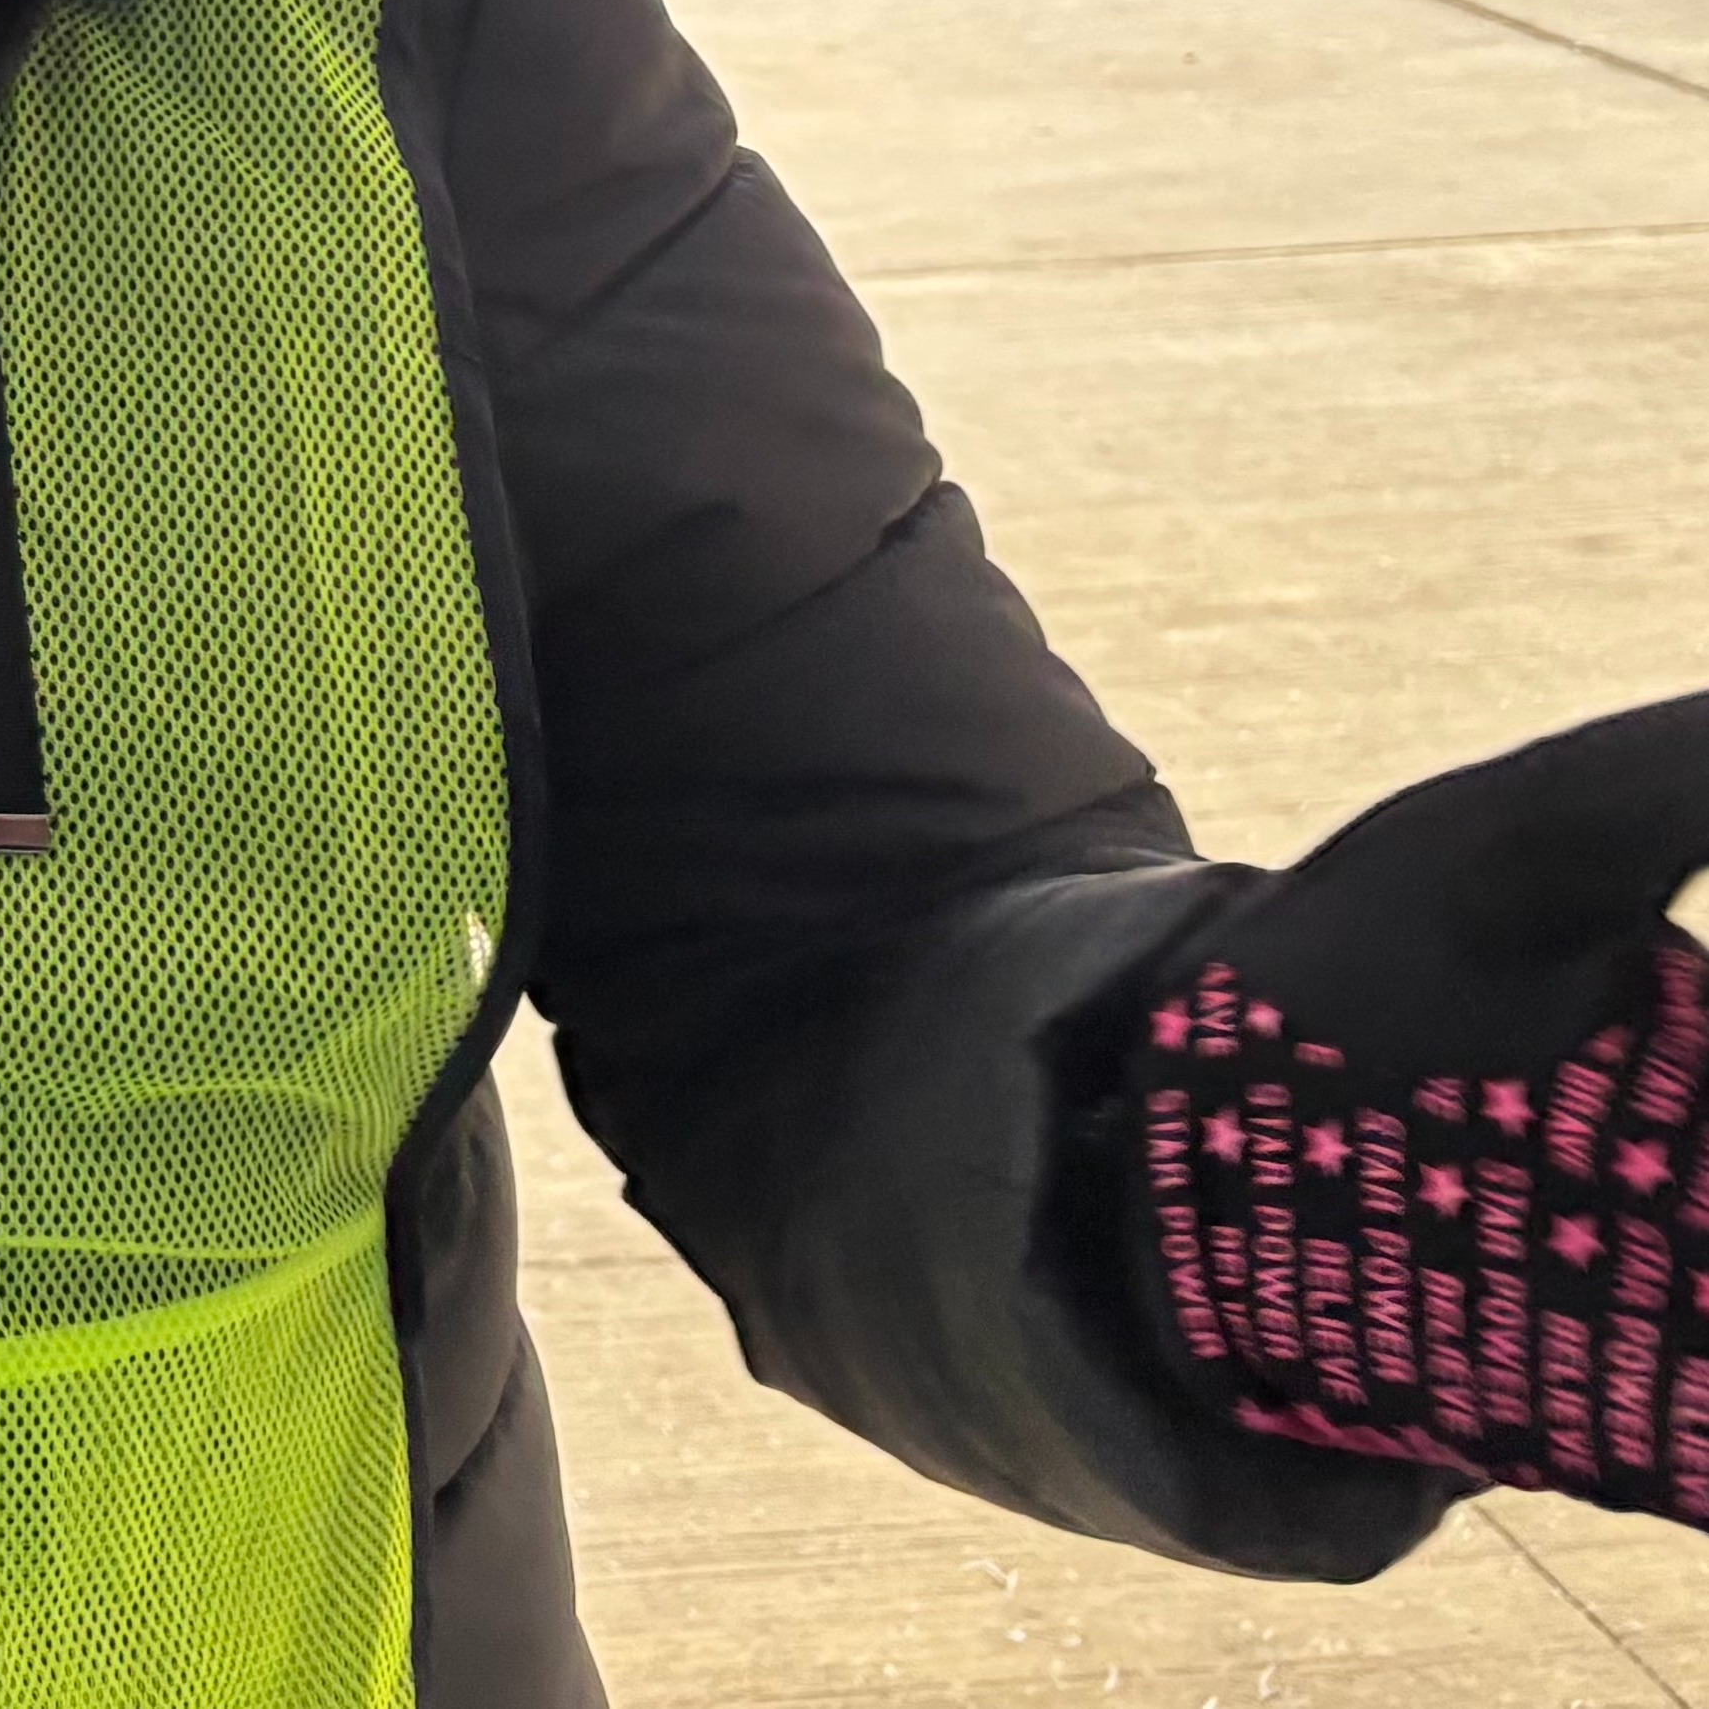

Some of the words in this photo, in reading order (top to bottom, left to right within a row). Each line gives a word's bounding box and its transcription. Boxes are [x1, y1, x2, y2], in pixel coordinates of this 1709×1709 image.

[1156, 1205, 1227, 1360] POWER
[1251, 1205, 1303, 1361] POWER
[1358, 1226, 1417, 1384] POWER
